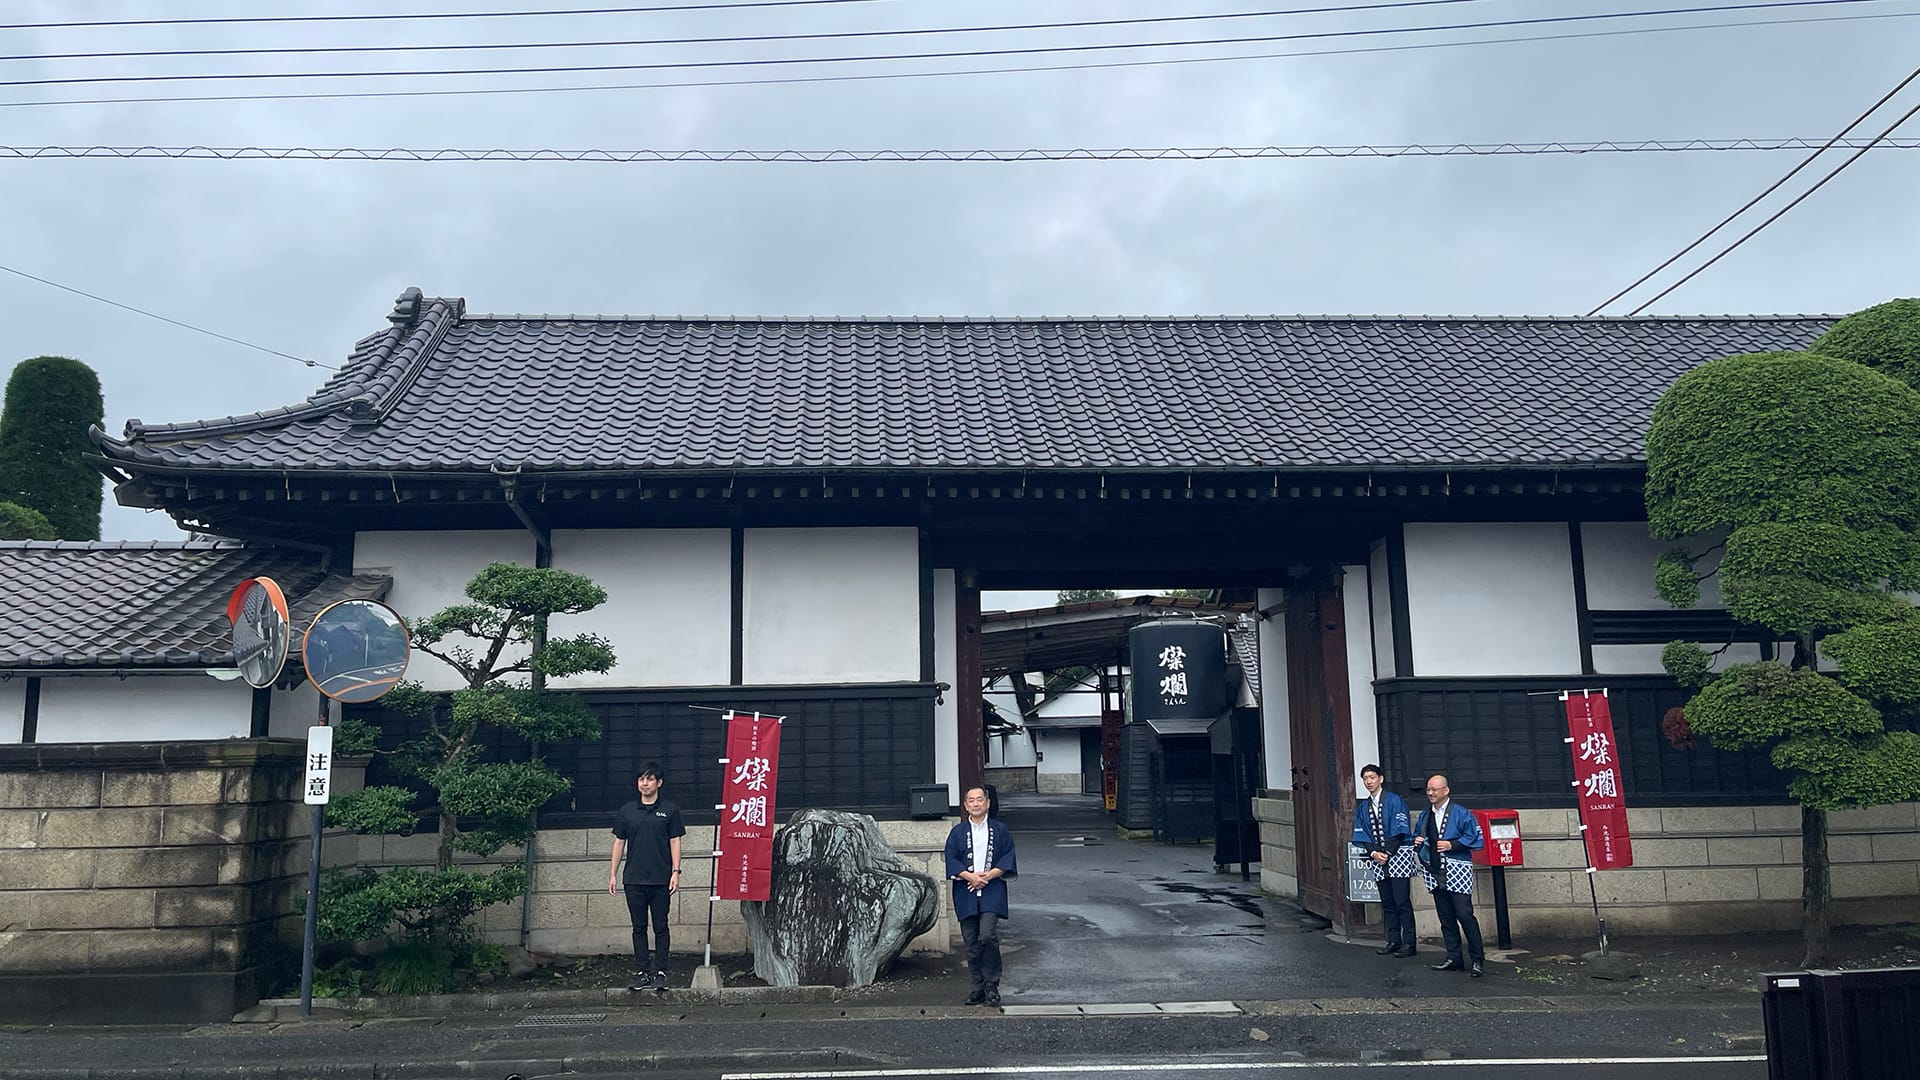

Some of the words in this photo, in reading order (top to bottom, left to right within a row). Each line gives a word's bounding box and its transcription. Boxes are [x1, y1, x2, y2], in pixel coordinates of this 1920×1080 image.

[1159, 645, 1188, 697] 燦爛
[308, 753, 328, 796] 注意
[1580, 732, 1617, 798] 燦爛
[730, 756, 771, 827] 燦爛
[1590, 803, 1615, 811] SANRAN
[733, 831, 760, 839] SANRAN
